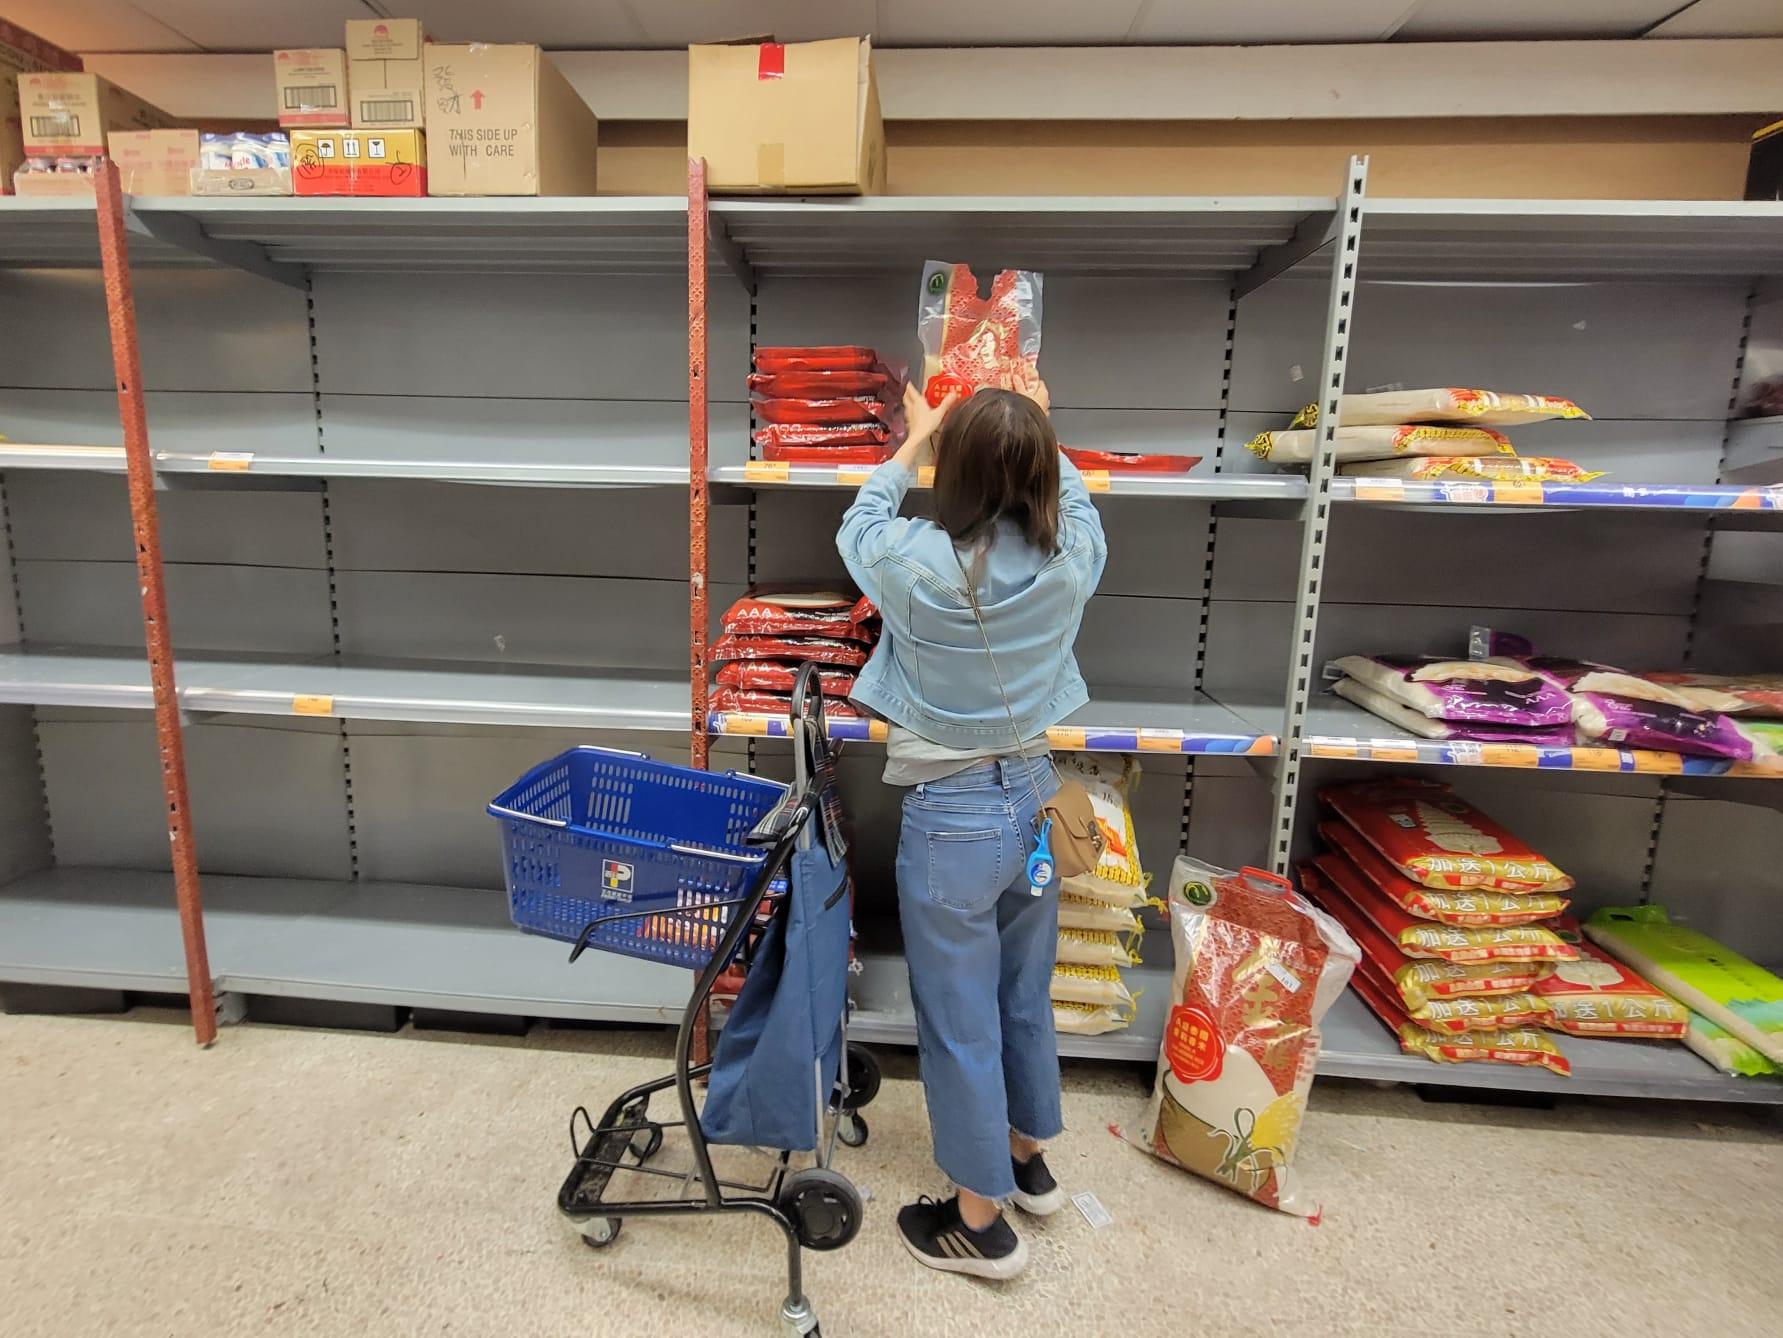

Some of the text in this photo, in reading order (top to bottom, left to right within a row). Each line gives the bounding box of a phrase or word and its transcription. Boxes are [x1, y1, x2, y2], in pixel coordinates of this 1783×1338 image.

[449, 129, 518, 140] THIS SIDE UP
[449, 145, 514, 156] WITH CARE
[737, 607, 773, 617] AAA
[1429, 857, 1553, 882] 加送1公斤
[1415, 927, 1542, 947] 加送1公斤
